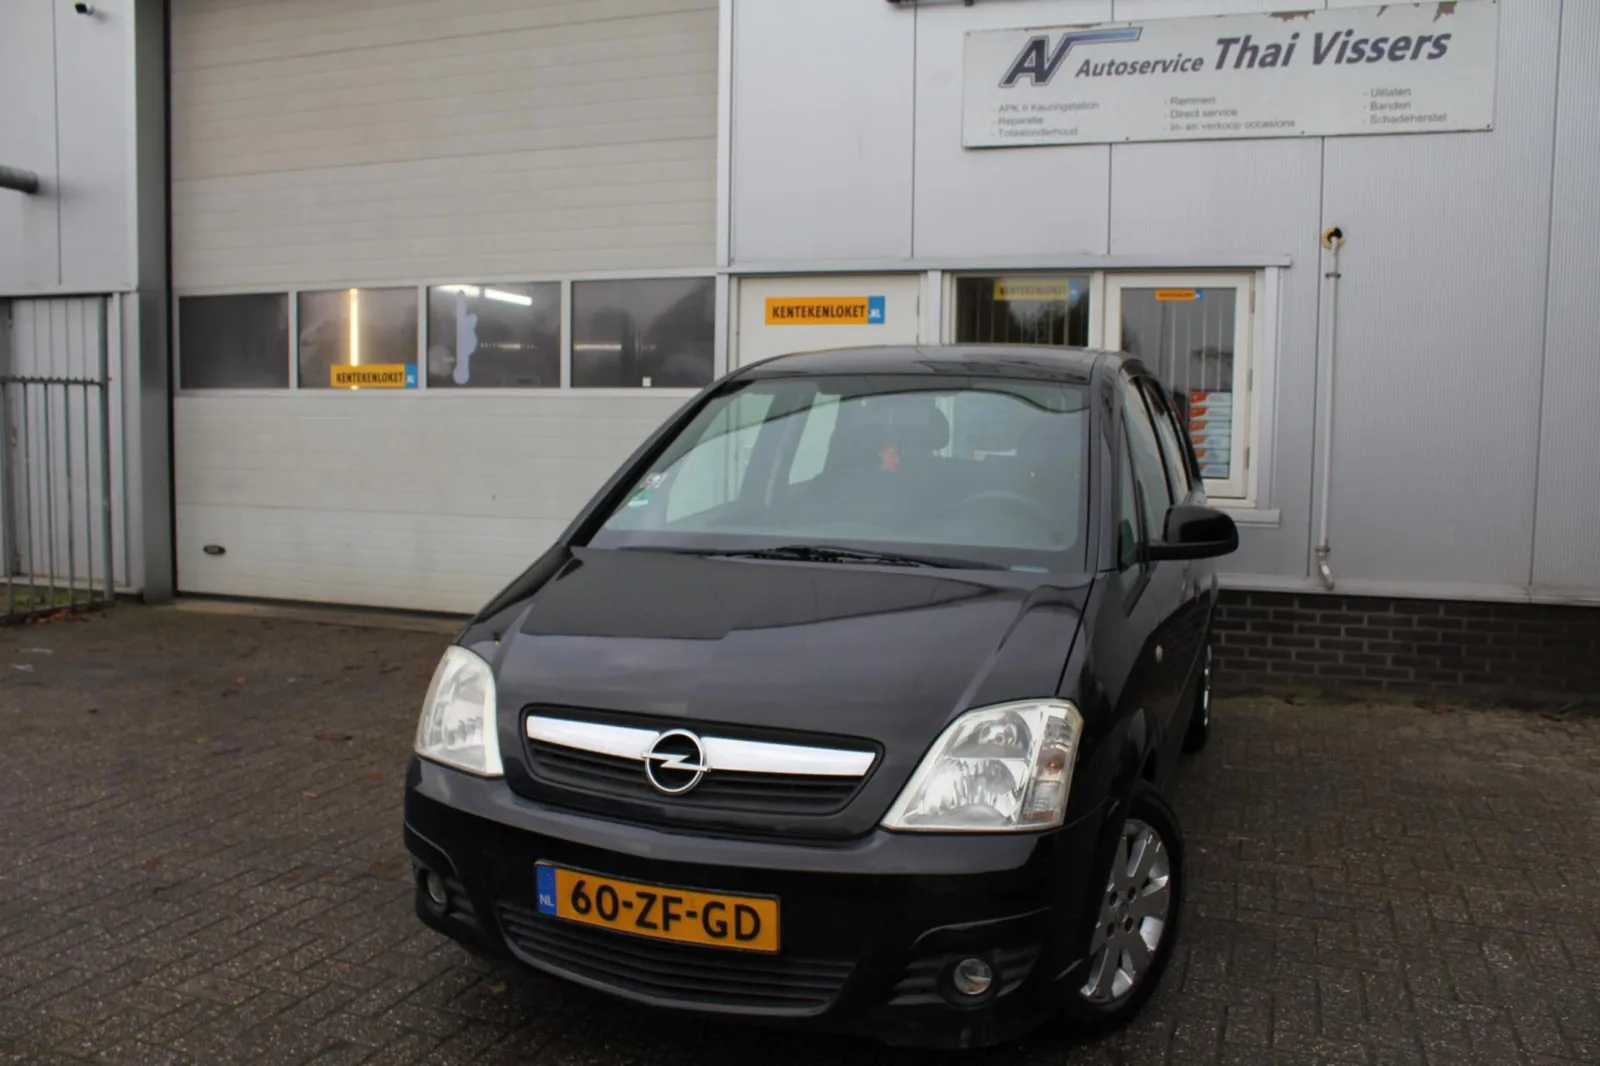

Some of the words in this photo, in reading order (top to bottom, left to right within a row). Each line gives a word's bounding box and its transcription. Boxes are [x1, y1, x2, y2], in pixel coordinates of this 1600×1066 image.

[1075, 53, 1204, 78] Autoservice
[1214, 33, 1300, 71] Thai
[1311, 29, 1452, 66] Vissers
[1370, 87, 1412, 98] Uitlaten
[1170, 97, 1216, 106] Remmen
[1370, 101, 1412, 111] Banden
[1170, 109, 1200, 119] Direct
[1202, 109, 1238, 118] service
[1202, 120, 1241, 131] verkoop
[1244, 118, 1296, 129] occasions
[539, 893, 555, 907] NL
[570, 879, 761, 942] 60-ZF-GD
